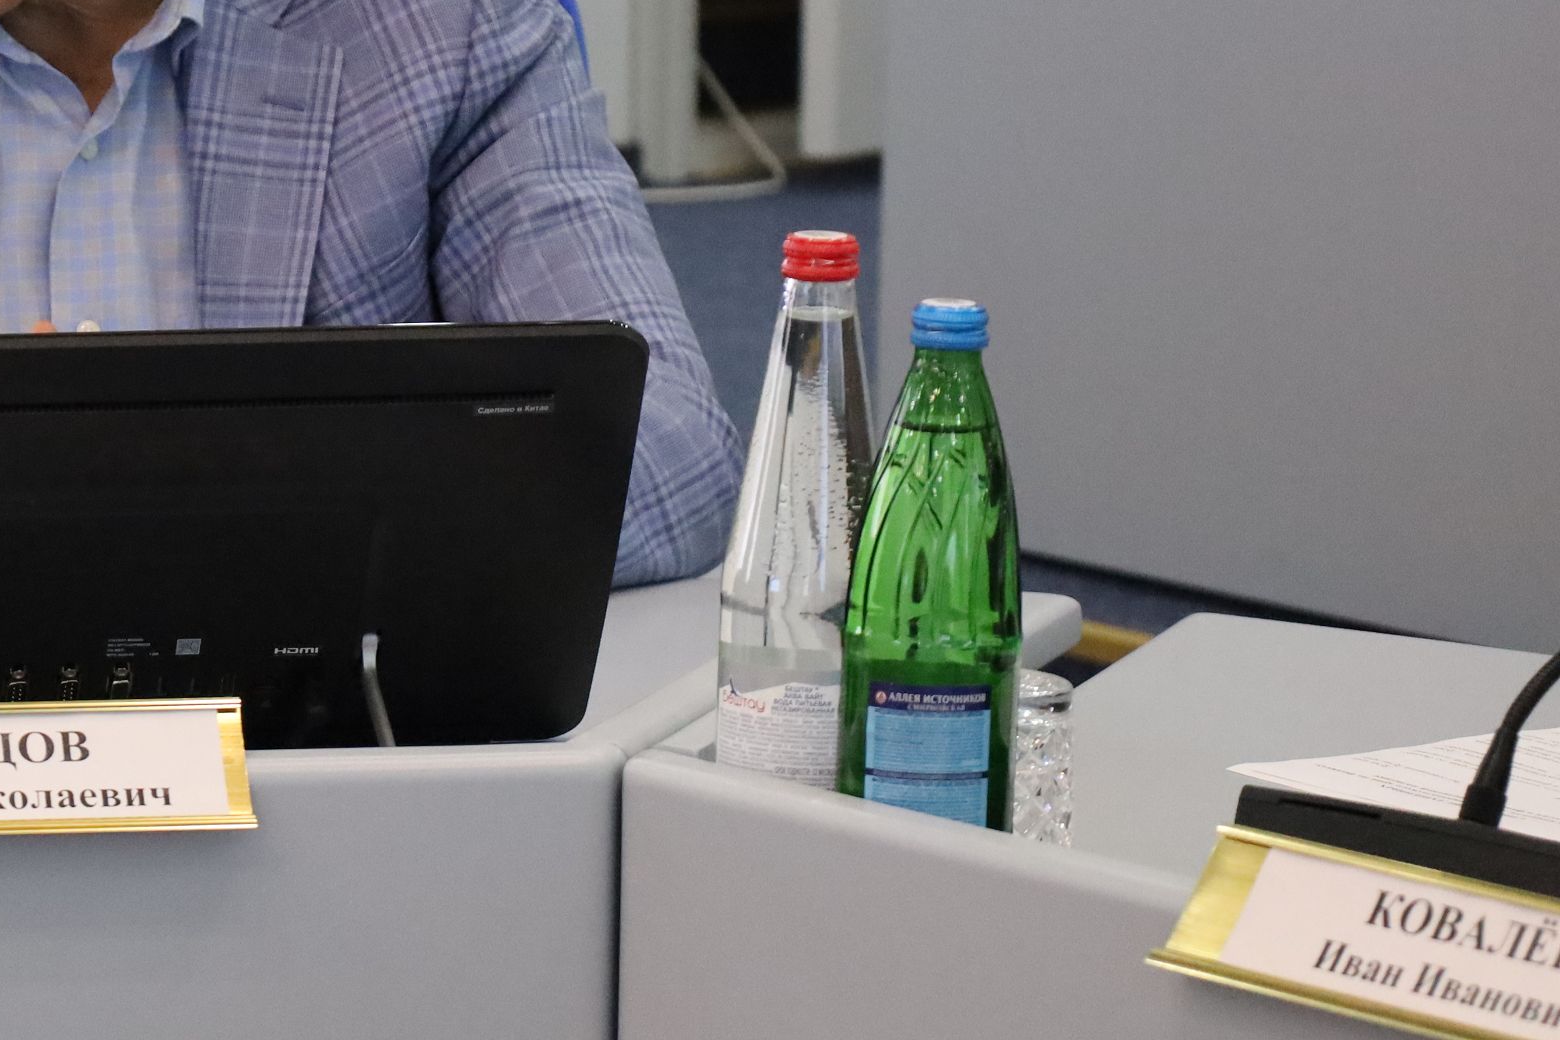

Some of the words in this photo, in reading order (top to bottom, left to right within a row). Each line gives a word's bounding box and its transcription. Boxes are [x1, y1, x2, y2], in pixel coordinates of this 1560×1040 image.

[888, 691, 921, 702] АЛЛЕЯ
[923, 693, 987, 704] ИСТОЧНИКОВ
[1365, 889, 1560, 968] КОВАЛЁ
[1312, 938, 1403, 989] Иван
